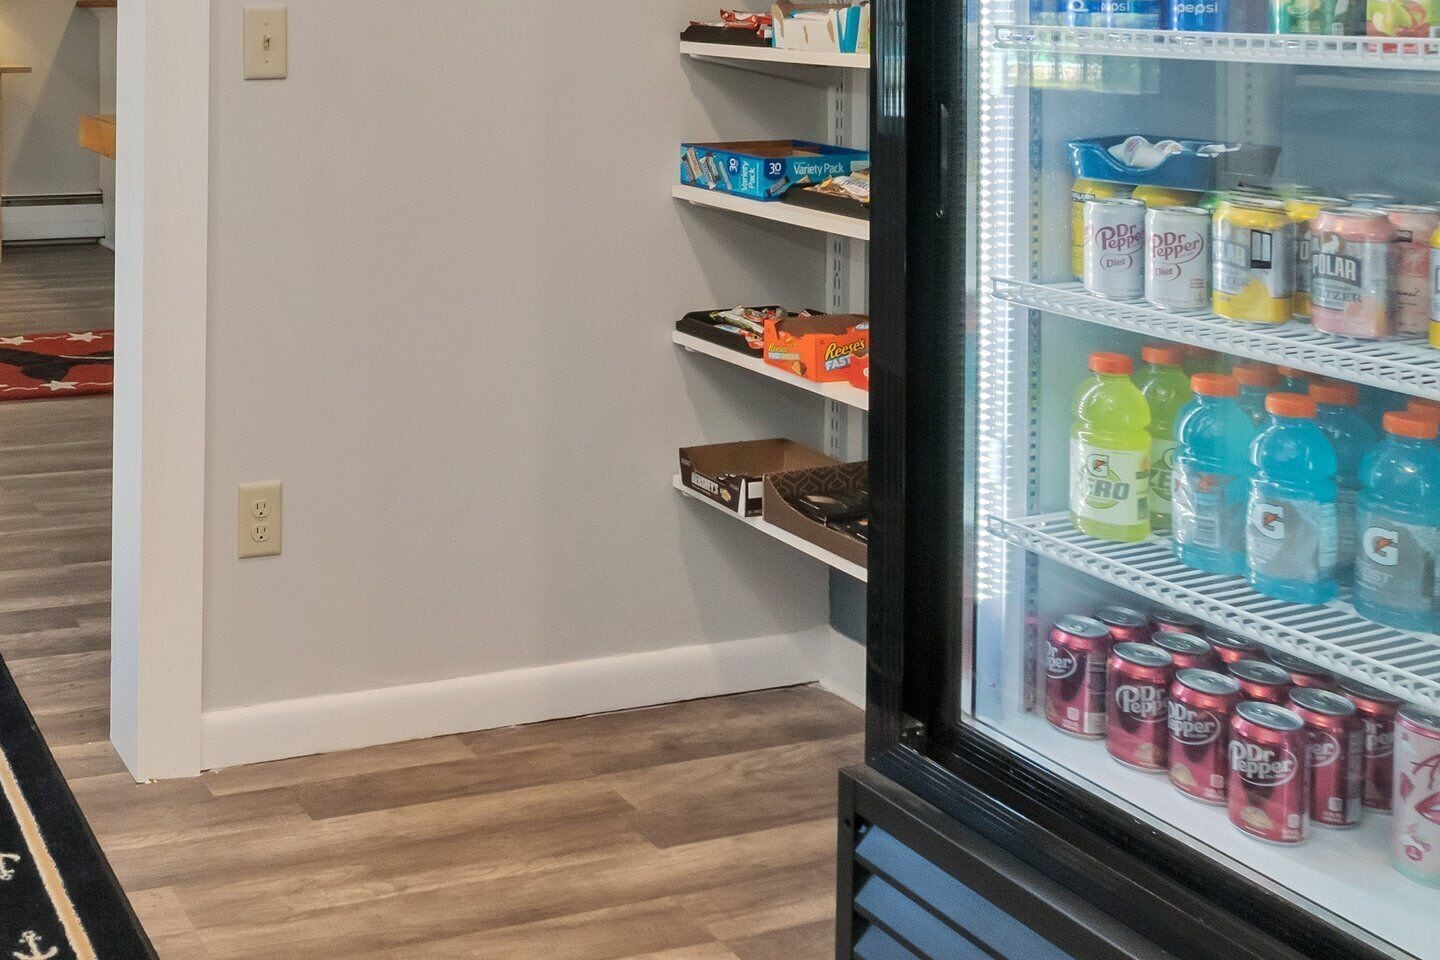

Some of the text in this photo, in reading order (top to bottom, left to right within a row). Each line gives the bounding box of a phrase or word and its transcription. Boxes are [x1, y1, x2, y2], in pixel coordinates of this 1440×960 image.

[1176, 2, 1219, 15] pepsi
[768, 162, 782, 175] 30
[793, 162, 844, 177] Variety Pack
[1101, 226, 1144, 251] Peppe
[1116, 224, 1137, 238] Dr
[1164, 232, 1186, 246] Dr
[1152, 234, 1200, 260] Pepper
[1106, 258, 1126, 268] Diet
[1155, 266, 1173, 277] Diet
[1312, 253, 1357, 281] POLAR
[825, 338, 866, 361] Reese's
[826, 355, 850, 371] FAST
[1254, 503, 1285, 540] G
[1363, 526, 1399, 566] G
[1172, 704, 1197, 721] Dr
[1229, 741, 1294, 779] Pepper
[1247, 743, 1276, 762] Dr
